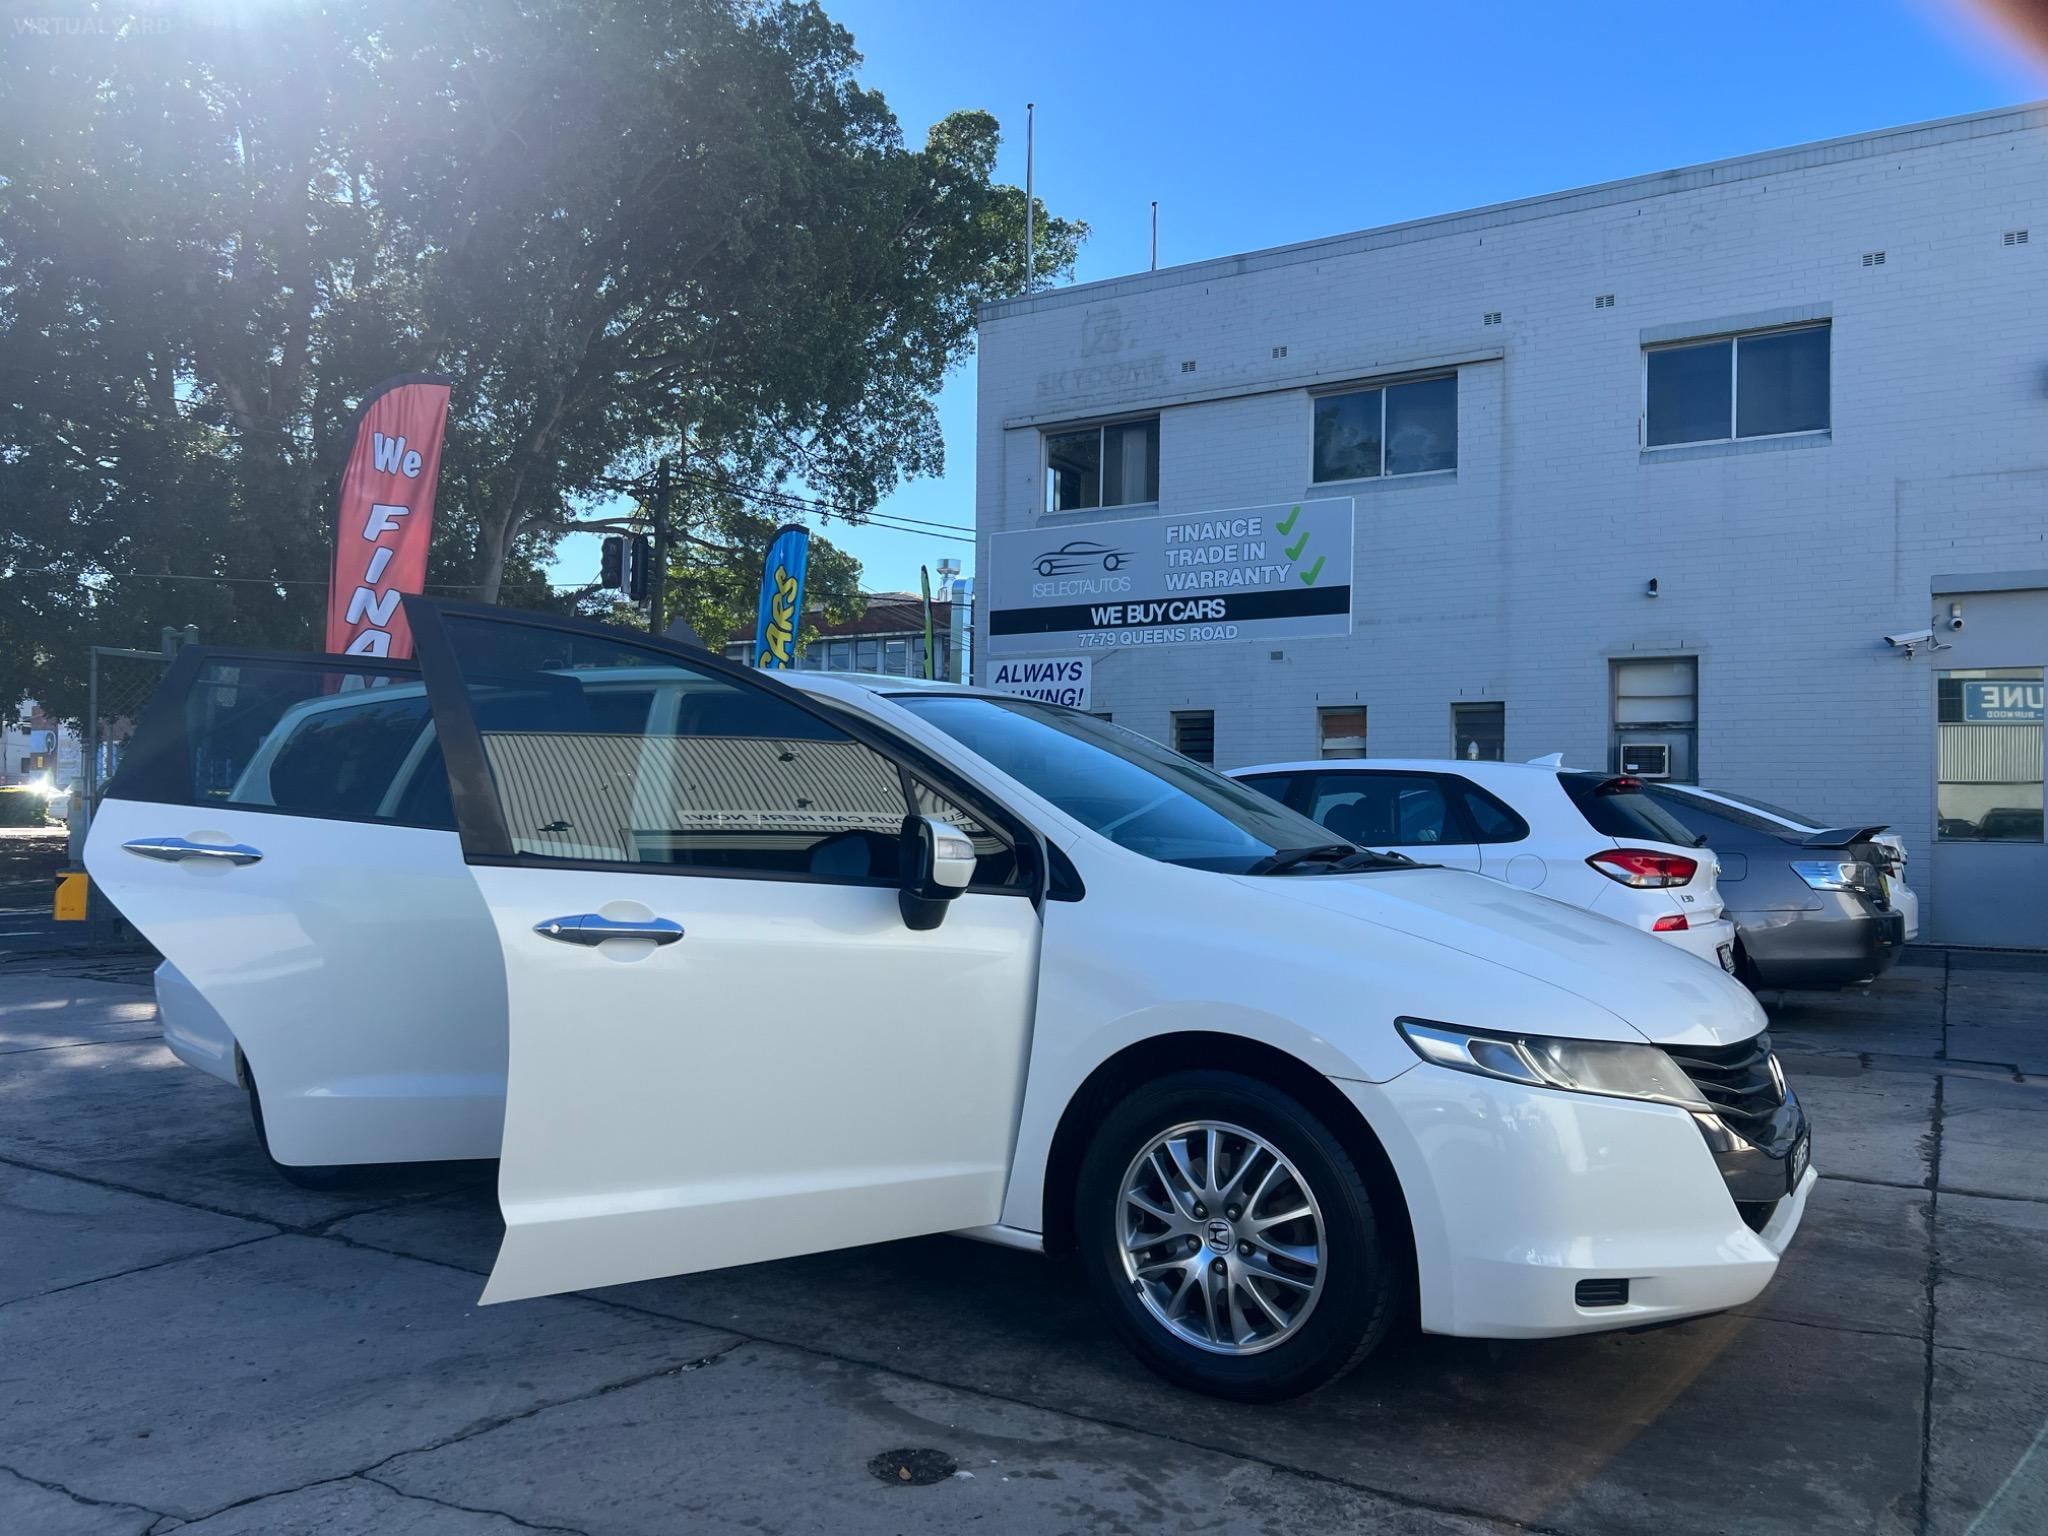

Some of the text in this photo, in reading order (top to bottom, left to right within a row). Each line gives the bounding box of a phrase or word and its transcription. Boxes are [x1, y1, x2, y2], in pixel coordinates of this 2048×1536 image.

[372, 431, 423, 479] We
[1166, 517, 1262, 544] FINANCE
[1165, 541, 1266, 567] TRADE IN
[1164, 563, 1292, 591] WARRANTY
[1091, 598, 1226, 626] WE BUY CARS
[1078, 625, 1239, 647] 77-79 QUEENS ROAD
[995, 661, 1084, 684] ALWAYS
[1001, 687, 1085, 708] YING!
